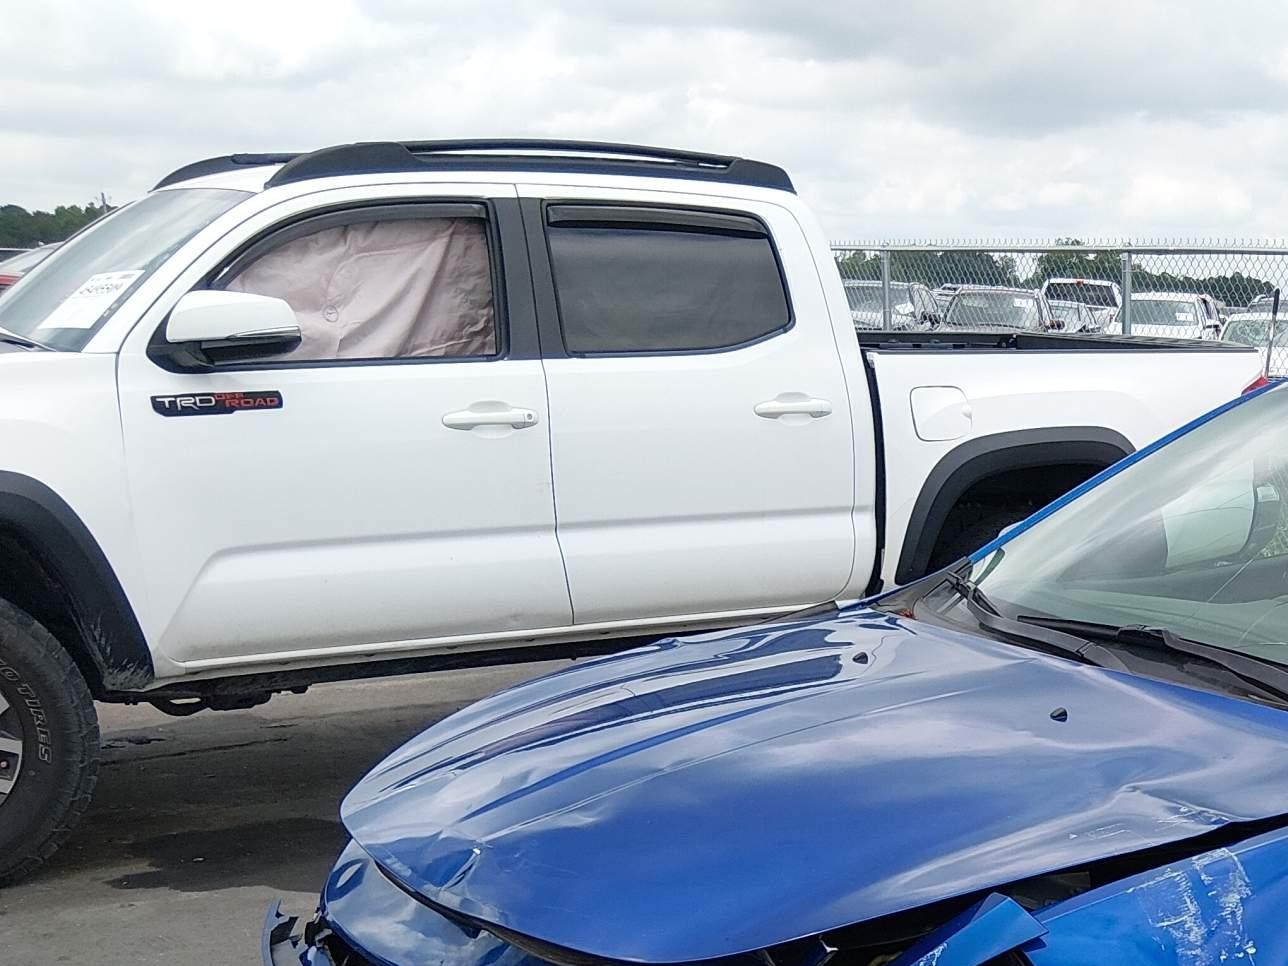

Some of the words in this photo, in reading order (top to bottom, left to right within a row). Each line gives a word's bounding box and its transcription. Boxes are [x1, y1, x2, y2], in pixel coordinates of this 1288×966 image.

[155, 395, 217, 411] TRD
[224, 396, 280, 408] ROAD
[17, 682, 53, 765] TIRES
